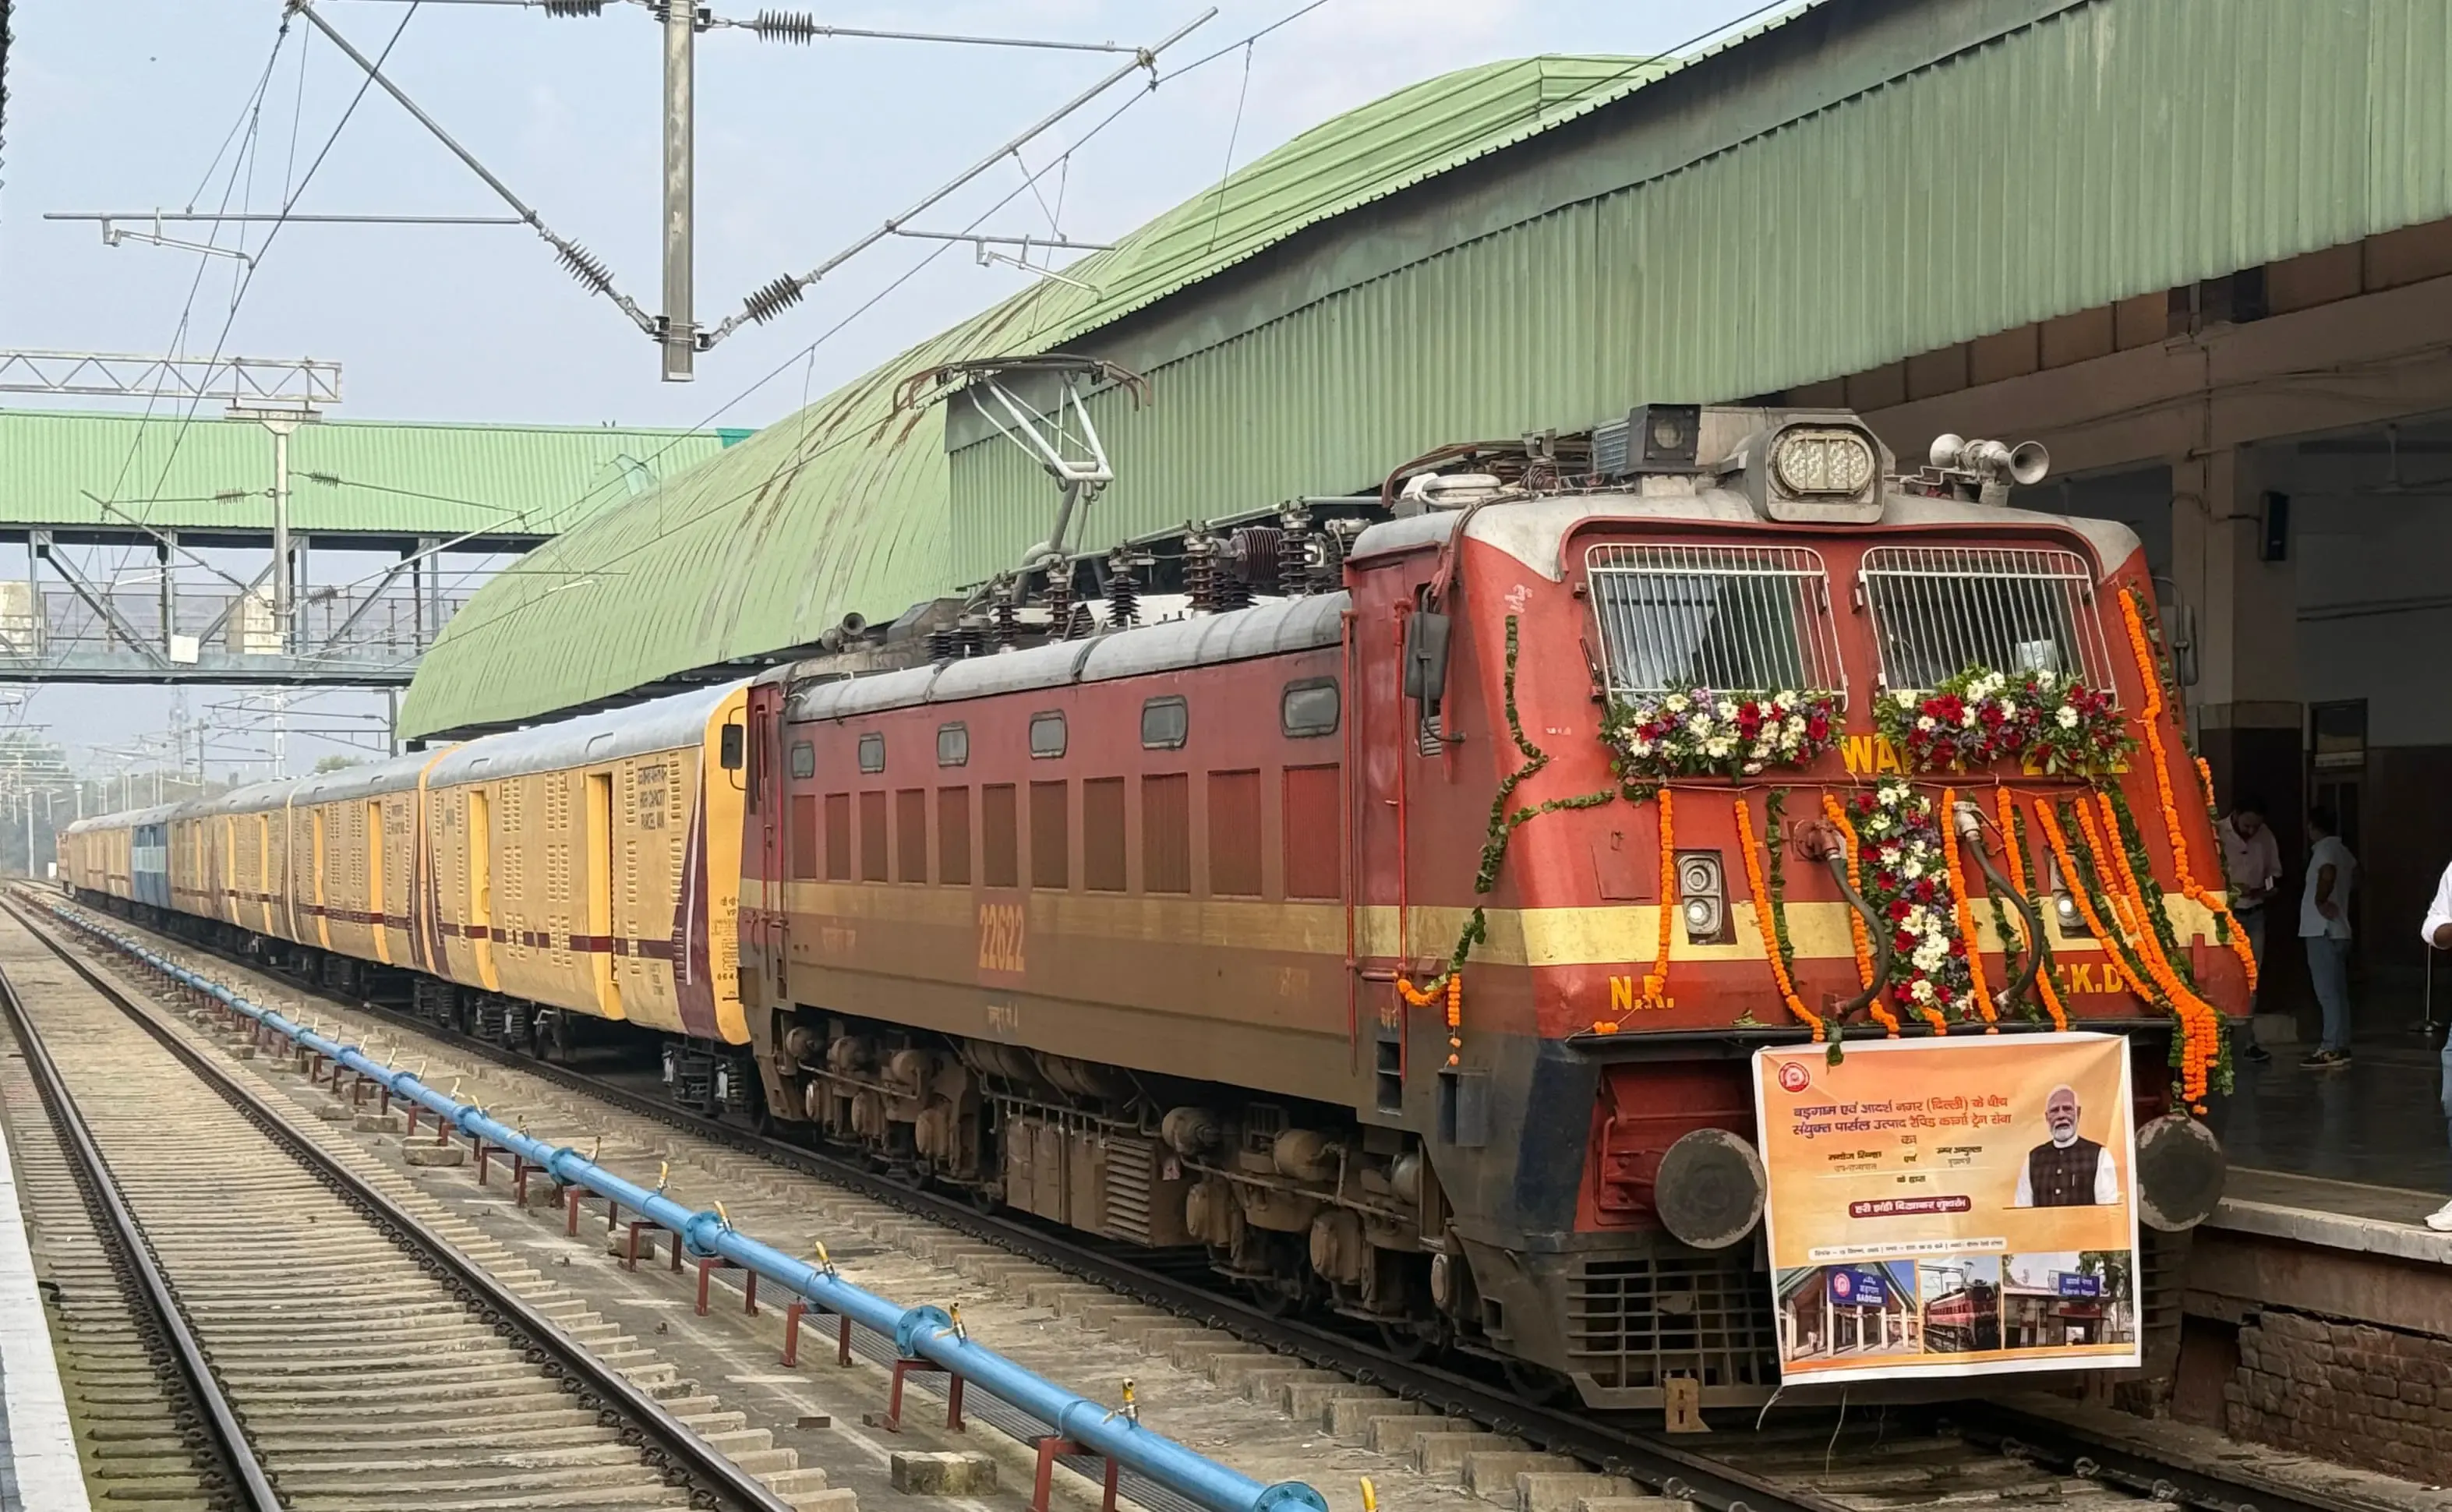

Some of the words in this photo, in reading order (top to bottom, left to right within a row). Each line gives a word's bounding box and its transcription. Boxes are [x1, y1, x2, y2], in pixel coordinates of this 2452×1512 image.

[979, 903, 1025, 973] 22622
[1840, 1100, 1858, 1115] एवं
[1860, 1099, 1892, 1114] आदर्श
[1896, 1101, 1923, 1112] नगर
[1926, 1095, 1968, 1113] (दिल्ली)
[1971, 1095, 1984, 1108] के
[1987, 1094, 2009, 1108] बीच
[1792, 1122, 1832, 1139] संयुक्त
[1835, 1117, 1871, 1132] पार्सल
[1874, 1119, 1906, 1130] उत्पाद
[1909, 1115, 1936, 1128] रैपिड
[1972, 1112, 1987, 1129] ट्रेन
[1990, 1112, 2012, 1125] सेवा
[1900, 1134, 1917, 1144] का
